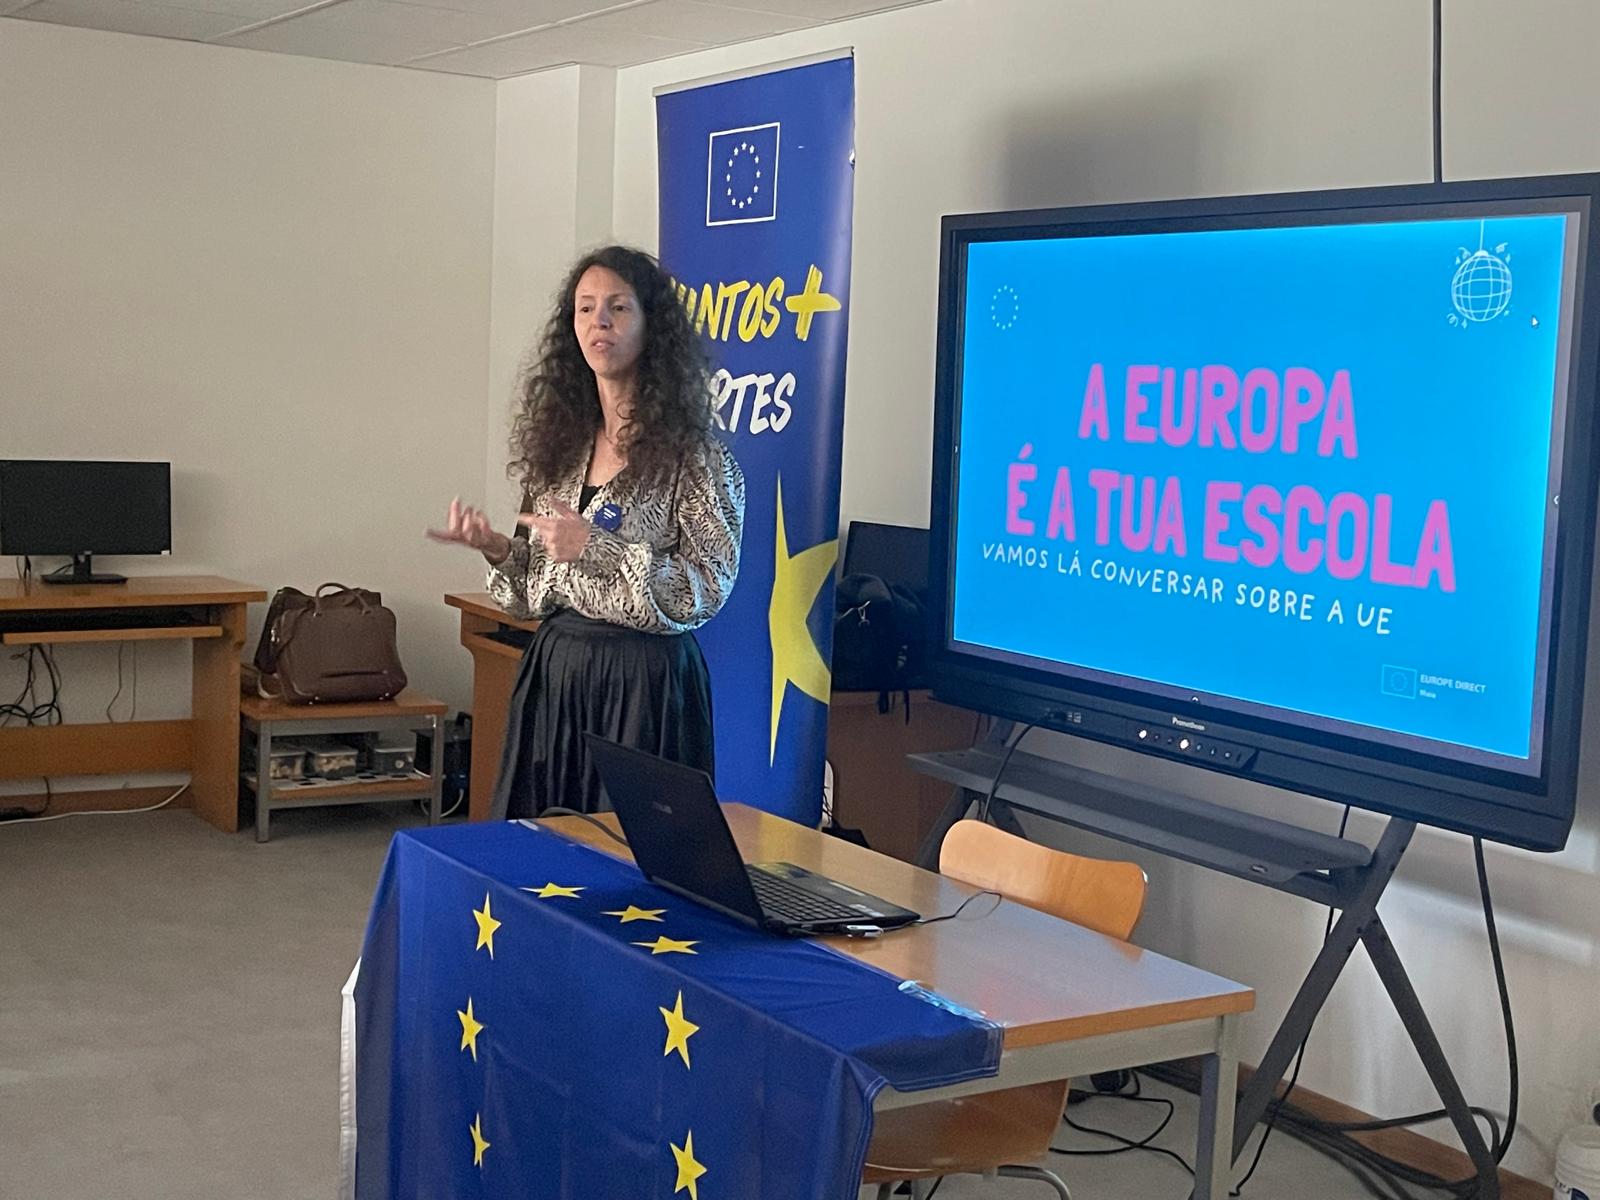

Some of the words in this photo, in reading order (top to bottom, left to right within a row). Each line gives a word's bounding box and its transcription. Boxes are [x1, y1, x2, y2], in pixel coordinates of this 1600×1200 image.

[670, 276, 785, 342] NTOS
[1078, 363, 1110, 440] A
[1124, 364, 1358, 459] EUROPA
[1006, 443, 1037, 536] É
[1046, 466, 1076, 542] A
[1089, 469, 1187, 557] TUA
[1203, 480, 1456, 593] ESCOLA
[982, 543, 1048, 568] VAMOS
[1058, 550, 1082, 576] LÁ
[1091, 559, 1224, 604] CONVERSAR
[1235, 583, 1315, 620] SOBRE
[1327, 600, 1344, 624] A
[1357, 603, 1393, 634] UE
[1420, 674, 1453, 689] EUROPE
[1455, 680, 1486, 693] DIRECT
